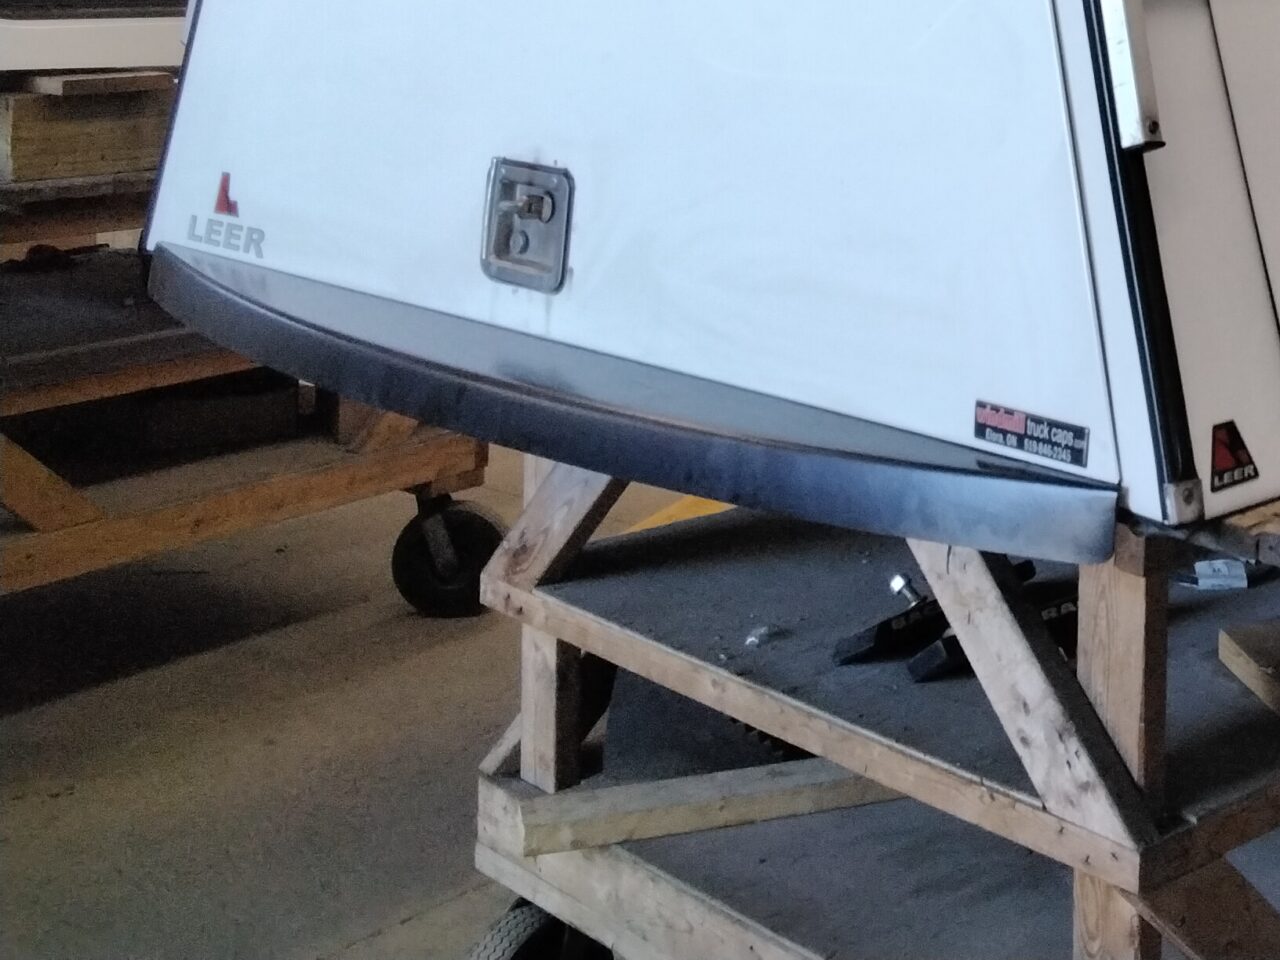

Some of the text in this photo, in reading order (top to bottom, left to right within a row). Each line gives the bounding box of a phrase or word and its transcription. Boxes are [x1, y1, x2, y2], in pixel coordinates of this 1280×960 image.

[187, 214, 266, 259] LEER
[1026, 417, 1049, 440] truck
[1051, 427, 1074, 448] caps
[1214, 464, 1255, 487] LEER
